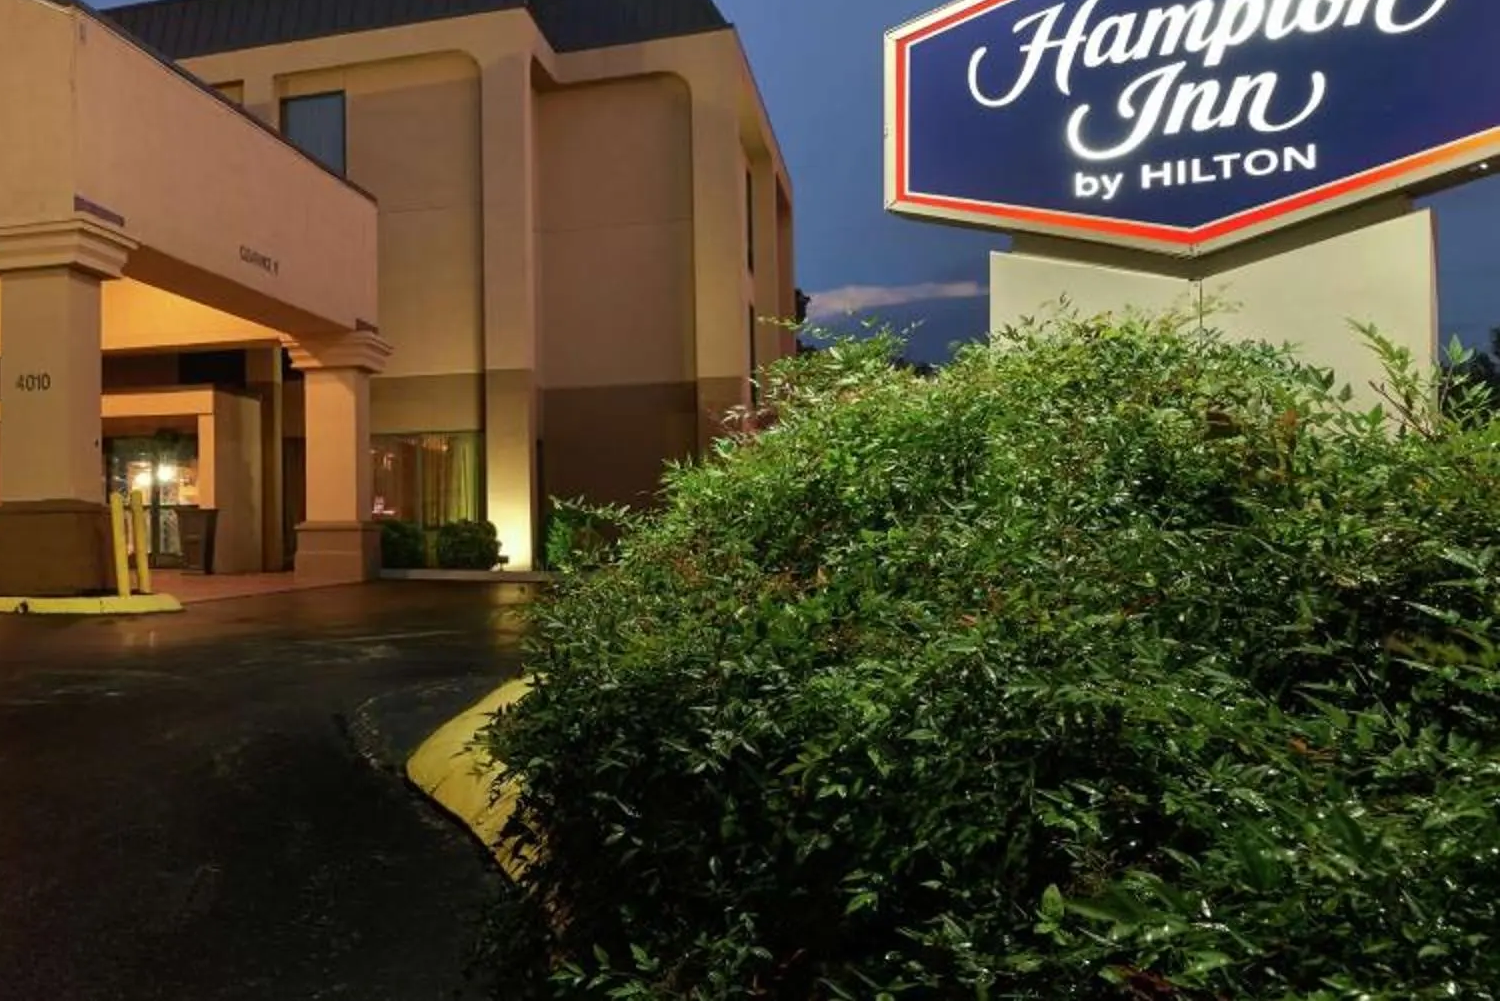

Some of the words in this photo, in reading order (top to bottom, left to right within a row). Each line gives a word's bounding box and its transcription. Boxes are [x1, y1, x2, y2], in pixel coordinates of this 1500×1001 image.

[1066, 61, 1326, 161] Inn
[1074, 171, 1124, 200] by
[1141, 143, 1316, 189] HILTON
[15, 373, 51, 392] 4010
